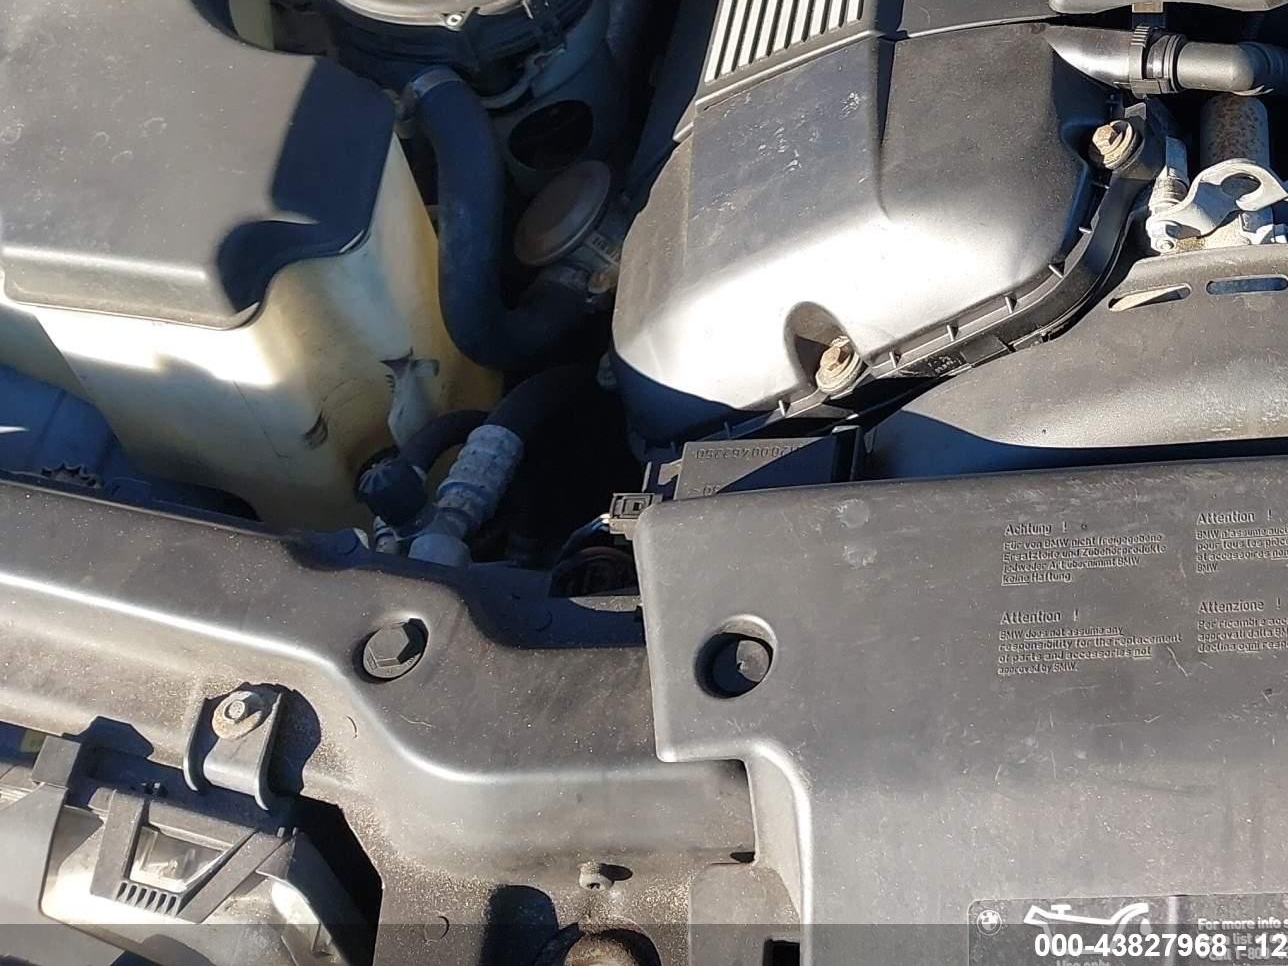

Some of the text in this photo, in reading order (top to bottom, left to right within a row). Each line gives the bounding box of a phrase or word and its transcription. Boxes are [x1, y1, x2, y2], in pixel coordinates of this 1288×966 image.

[1197, 510, 1255, 525] Attention
[1004, 522, 1052, 536] Achtung
[1195, 528, 1220, 540] BMW
[1024, 541, 1042, 549] von
[1043, 538, 1069, 548] BMW
[1071, 535, 1097, 548] nicht
[1196, 542, 1221, 553] pour
[1061, 549, 1080, 558] und
[1116, 555, 1140, 566] BMW
[1198, 599, 1264, 614] Attenzione
[1000, 610, 1061, 625] Attention
[999, 630, 1024, 641] BMW
[1074, 638, 1092, 648] for
[1112, 634, 1182, 647] replacement
[1044, 650, 1064, 660] and
[1197, 917, 1220, 930] For
[1221, 919, 1256, 930] more
[1257, 916, 1282, 929] info
